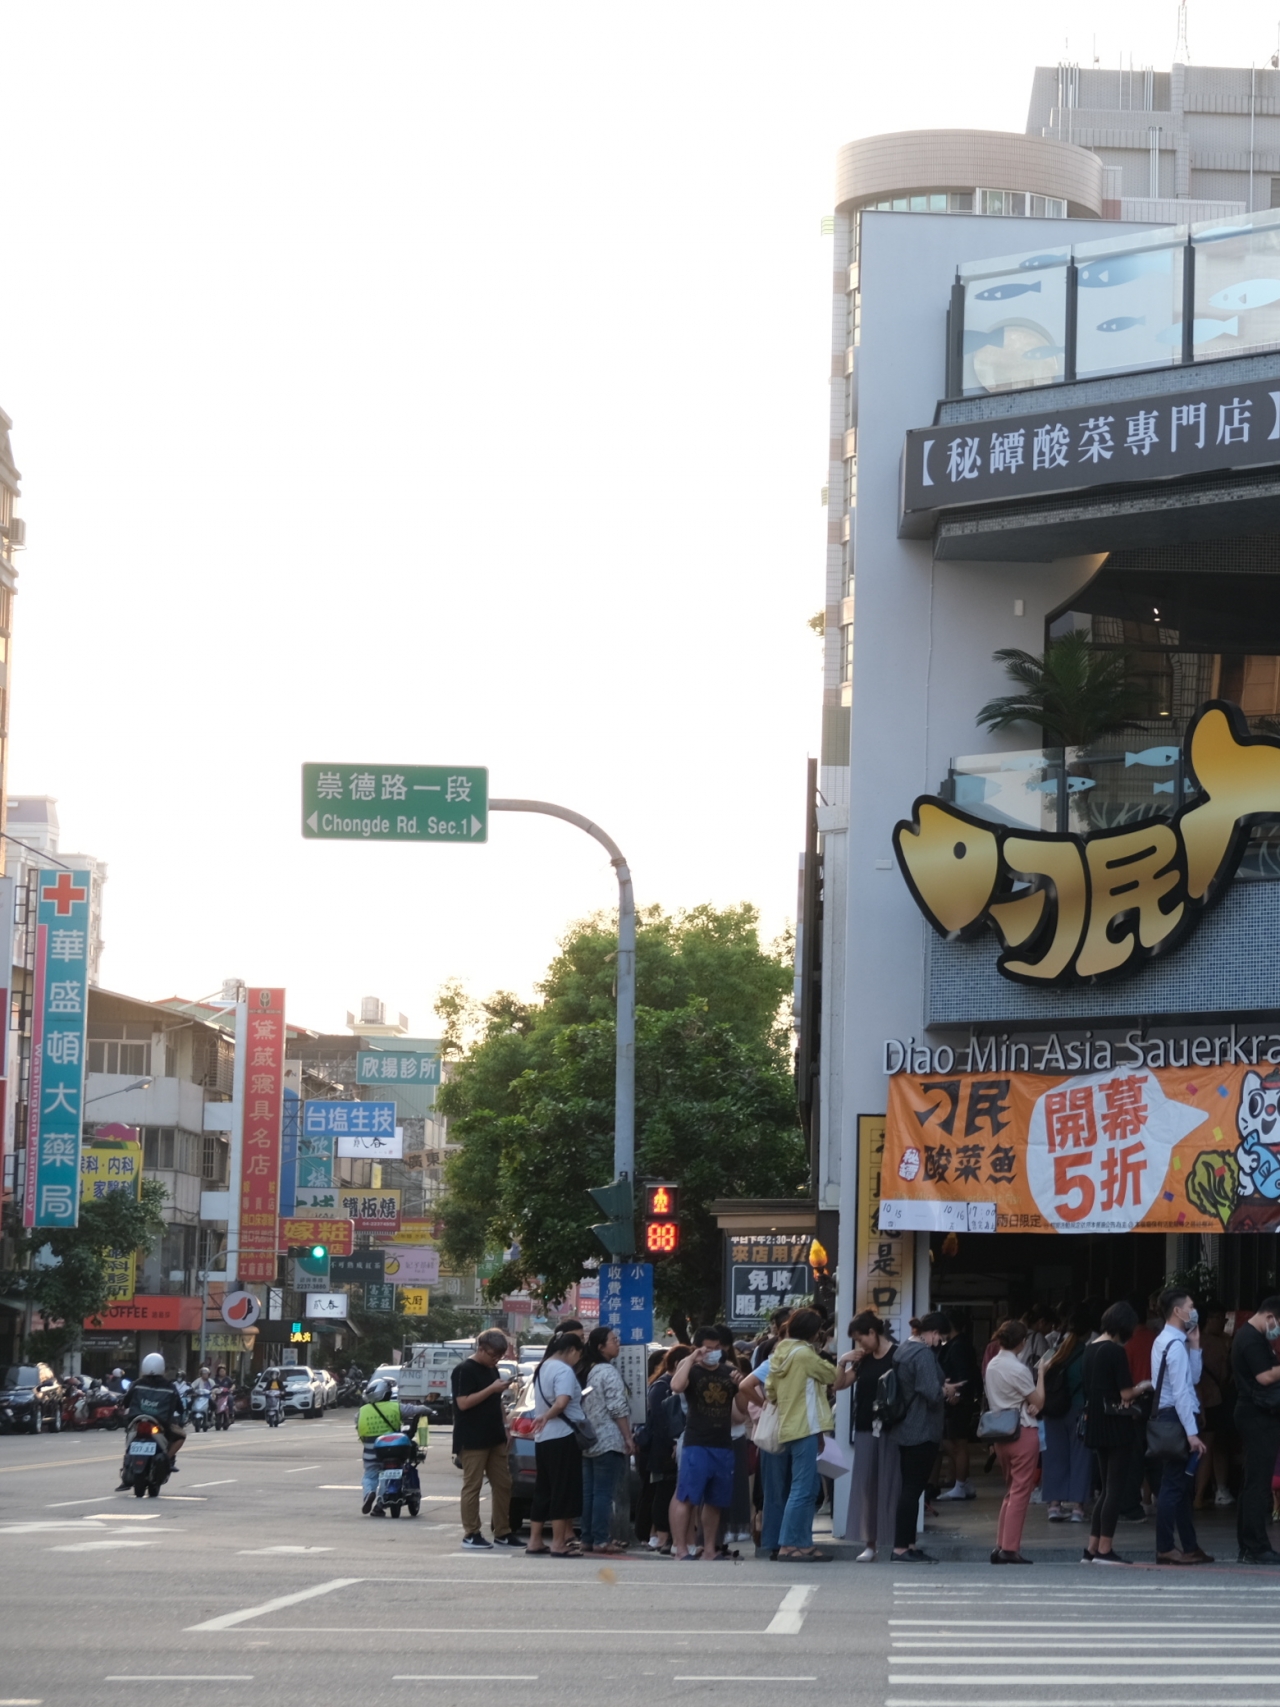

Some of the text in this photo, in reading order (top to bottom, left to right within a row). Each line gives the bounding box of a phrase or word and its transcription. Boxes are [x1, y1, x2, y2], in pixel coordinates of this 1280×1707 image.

[316, 771, 473, 802] 崇德路一段
[321, 813, 468, 837] Chongde Rd. Sec.1
[40, 928, 85, 1218] 華盛頓大藥局
[361, 1056, 437, 1080] 欣揚診所
[882, 1036, 956, 1076] Diao
[966, 1033, 1031, 1073] Min
[1040, 1030, 1114, 1072] Asia
[26, 1043, 42, 1211] Washington Pharmacy
[306, 1106, 393, 1133] 台塩生技
[913, 1078, 1012, 1139] 刁民
[1043, 1074, 1149, 1154] 開幕
[922, 1143, 1017, 1186] 酸菜魚
[1052, 1140, 1149, 1222] 5折
[342, 1197, 397, 1219] 鐵板燒
[731, 1245, 807, 1263] 來店用餐
[748, 1269, 792, 1291] 免收
[631, 1265, 645, 1342] 小型車
